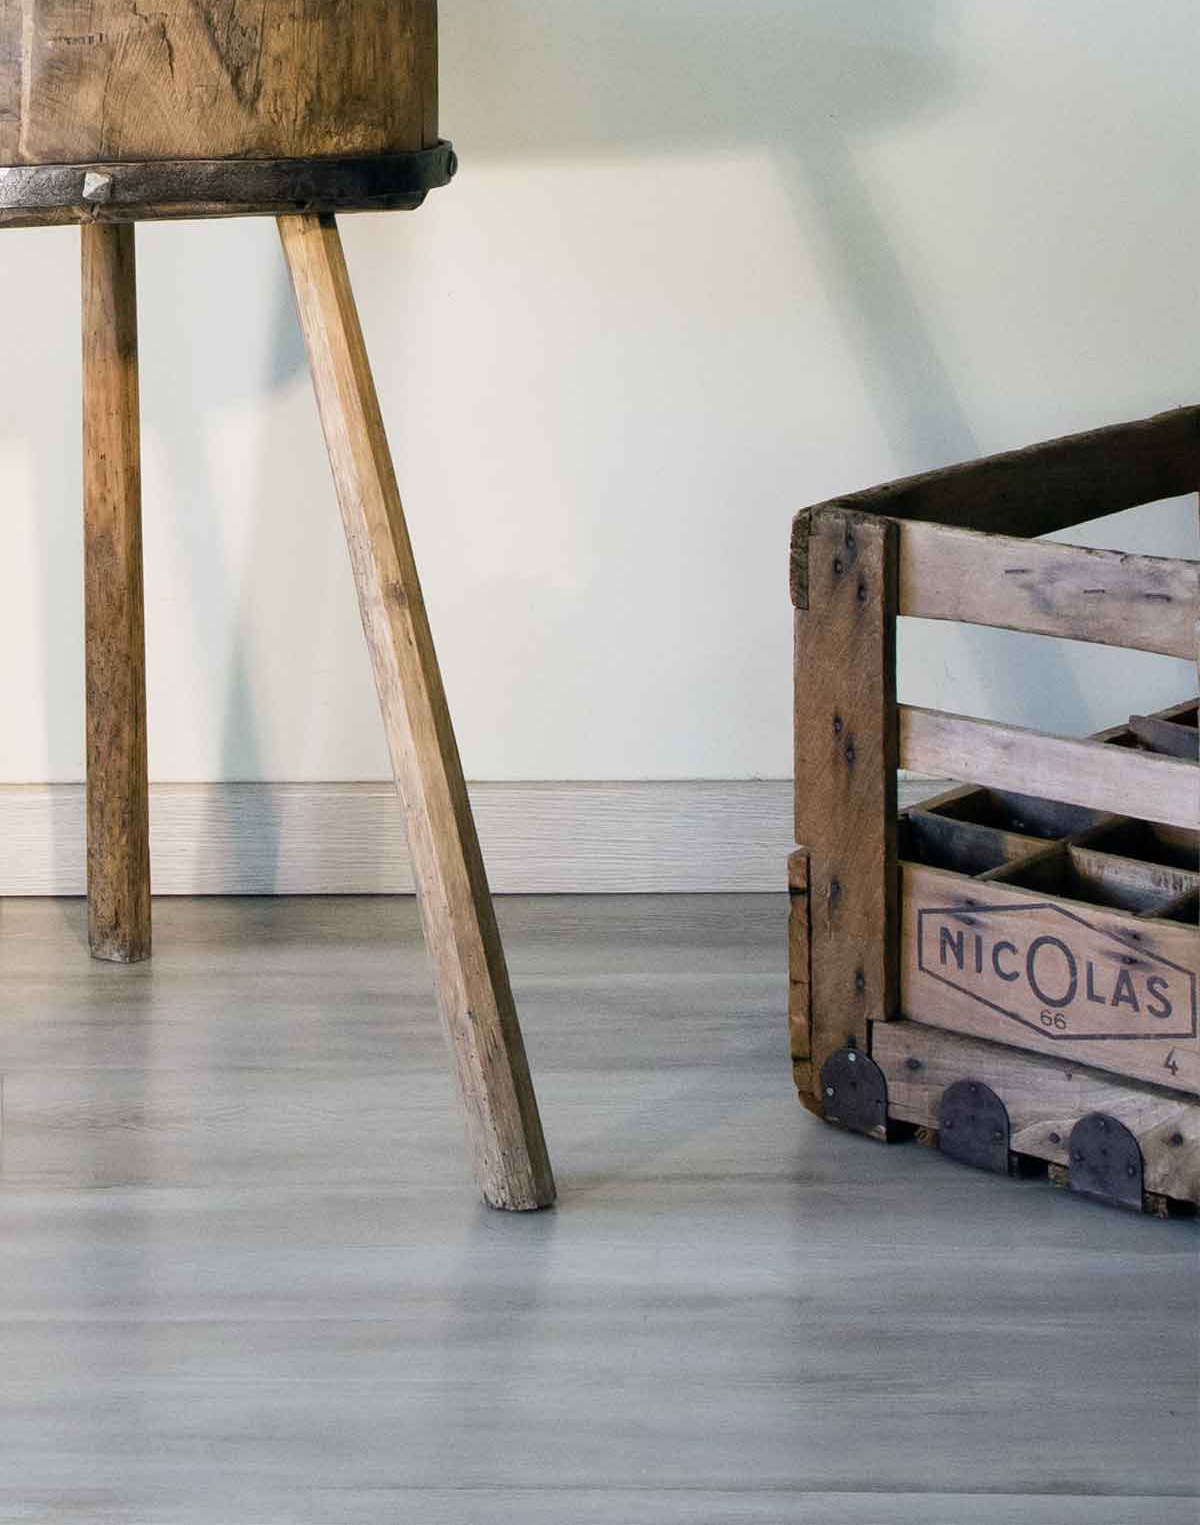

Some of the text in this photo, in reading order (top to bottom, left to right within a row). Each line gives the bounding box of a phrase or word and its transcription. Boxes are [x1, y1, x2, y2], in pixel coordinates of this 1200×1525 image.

[940, 927, 1173, 1019] NICOLAS
[1040, 1010, 1067, 1029] 66
[1164, 1047, 1178, 1075] 4
